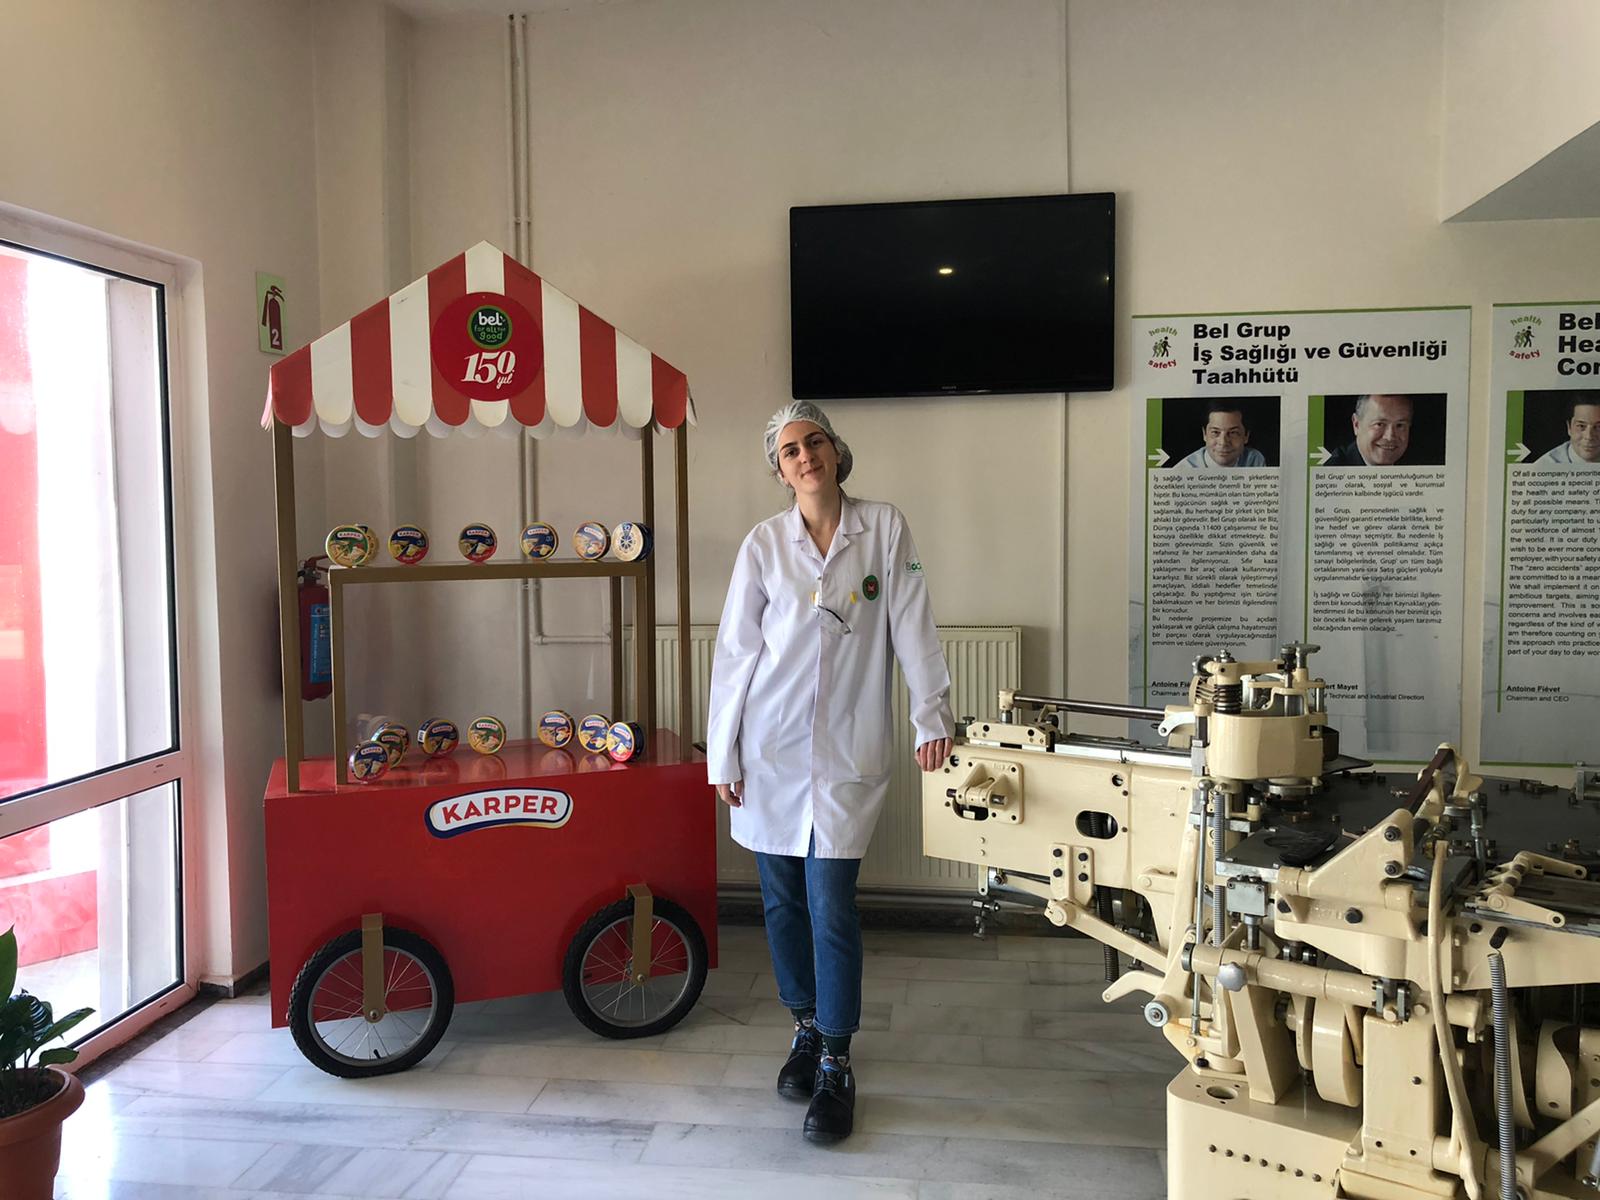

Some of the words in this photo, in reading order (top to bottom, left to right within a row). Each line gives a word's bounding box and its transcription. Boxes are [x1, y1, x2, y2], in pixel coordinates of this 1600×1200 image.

[478, 311, 503, 326] bel
[1510, 315, 1542, 326] health
[1559, 312, 1600, 330] Bel
[272, 329, 280, 345] 2
[480, 332, 503, 340] good
[1148, 326, 1178, 336] health
[1193, 323, 1228, 339] Bel
[1236, 322, 1290, 340] Grup
[1193, 343, 1212, 365] İş
[1220, 344, 1296, 364] Sağlığı
[1304, 346, 1330, 359] ve
[1338, 340, 1447, 361] Güvenliği
[1509, 349, 1541, 360] safety
[1148, 359, 1177, 369] safety
[1558, 358, 1600, 375] Co
[1192, 368, 1298, 385] Taahhütü
[442, 795, 558, 825] KARPER
